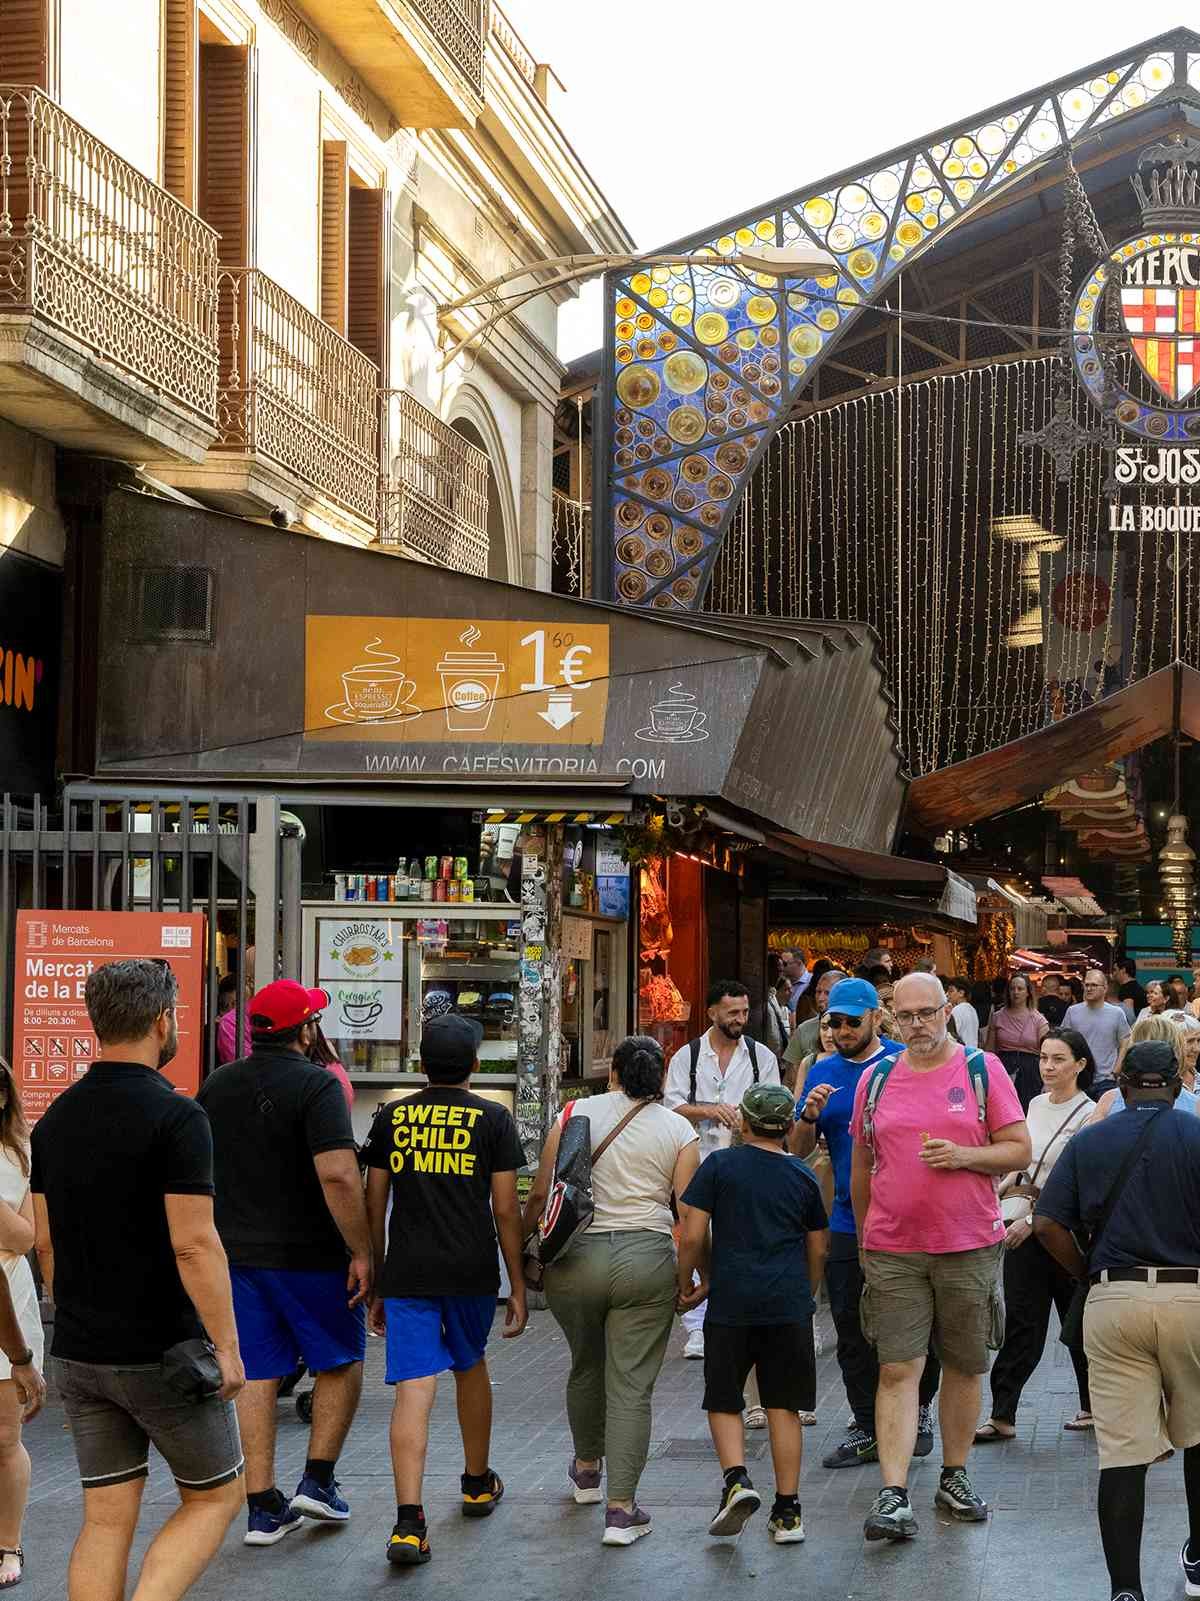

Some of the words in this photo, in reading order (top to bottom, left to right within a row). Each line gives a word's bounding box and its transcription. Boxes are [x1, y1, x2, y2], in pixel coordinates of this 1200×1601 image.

[1109, 505, 1135, 531] LA
[52, 925, 89, 934] Mercats
[52, 937, 64, 946] de
[67, 937, 114, 947] Barcelona
[26, 958, 94, 977] Mercat
[25, 981, 48, 998] de
[54, 981, 70, 998] la
[391, 1104, 483, 1128] SWEET
[393, 1125, 472, 1150] CHILD
